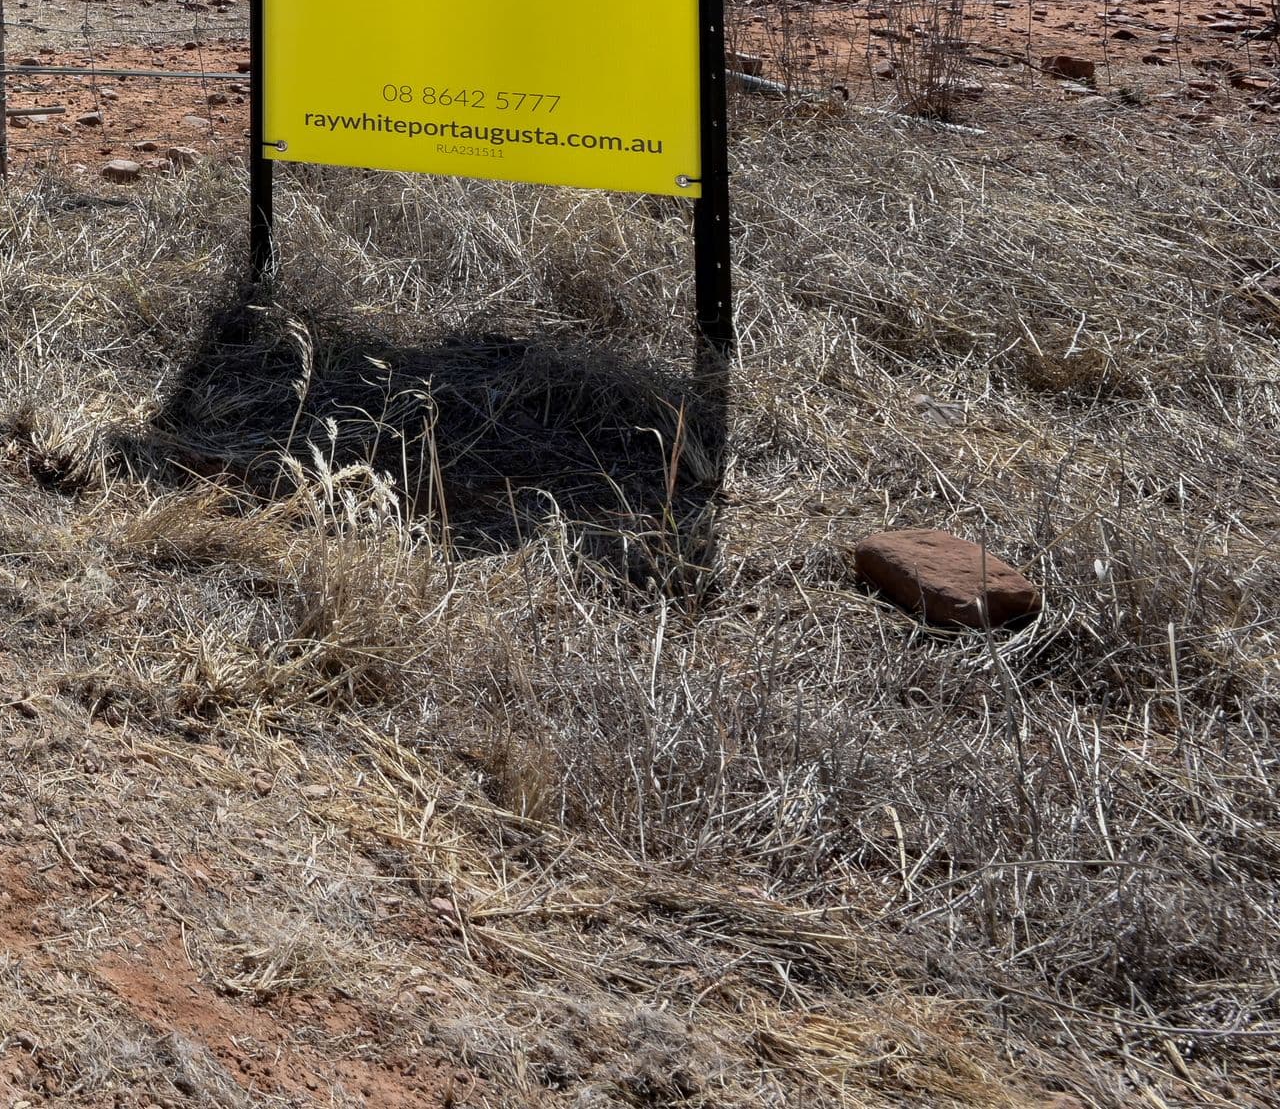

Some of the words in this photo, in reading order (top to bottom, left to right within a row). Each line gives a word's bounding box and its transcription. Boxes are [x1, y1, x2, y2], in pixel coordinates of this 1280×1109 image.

[382, 84, 413, 103] 08
[422, 87, 485, 109] 8642
[495, 91, 561, 113] 5777
[305, 112, 663, 154] raywhiteportaugusta.com.au
[436, 143, 504, 158] RLA231511
